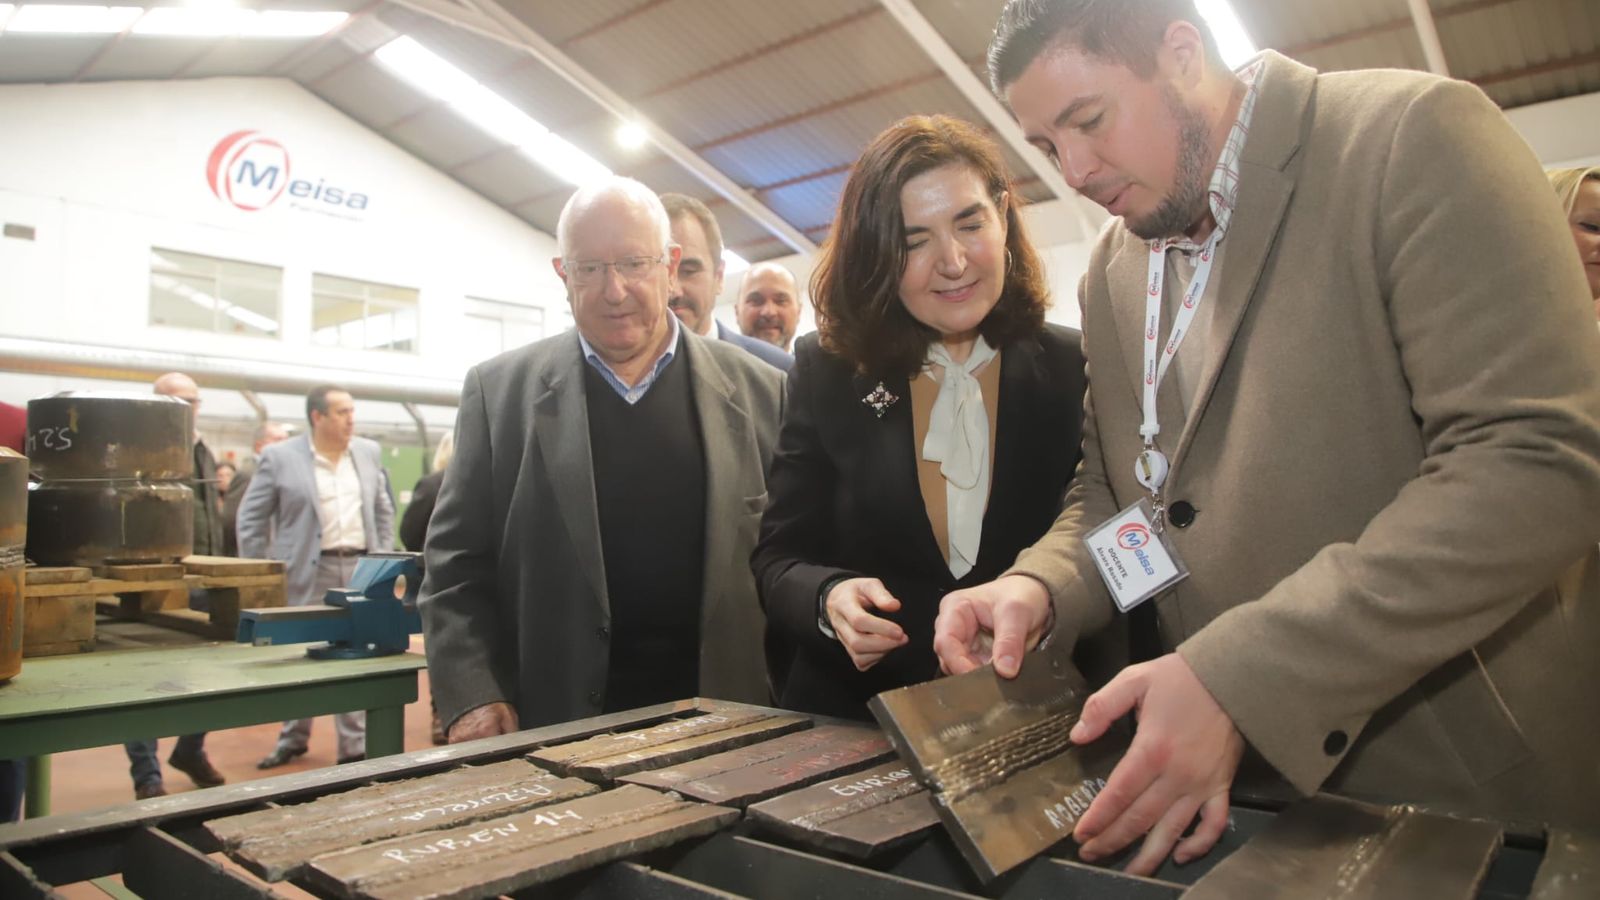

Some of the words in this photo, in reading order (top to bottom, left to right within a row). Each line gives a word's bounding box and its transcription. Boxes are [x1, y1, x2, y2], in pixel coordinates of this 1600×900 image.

[236, 160, 370, 211] Meisa
[1107, 546, 1128, 578] DOCENTE
[1125, 532, 1155, 576] Meisa
[534, 808, 584, 827] 14
